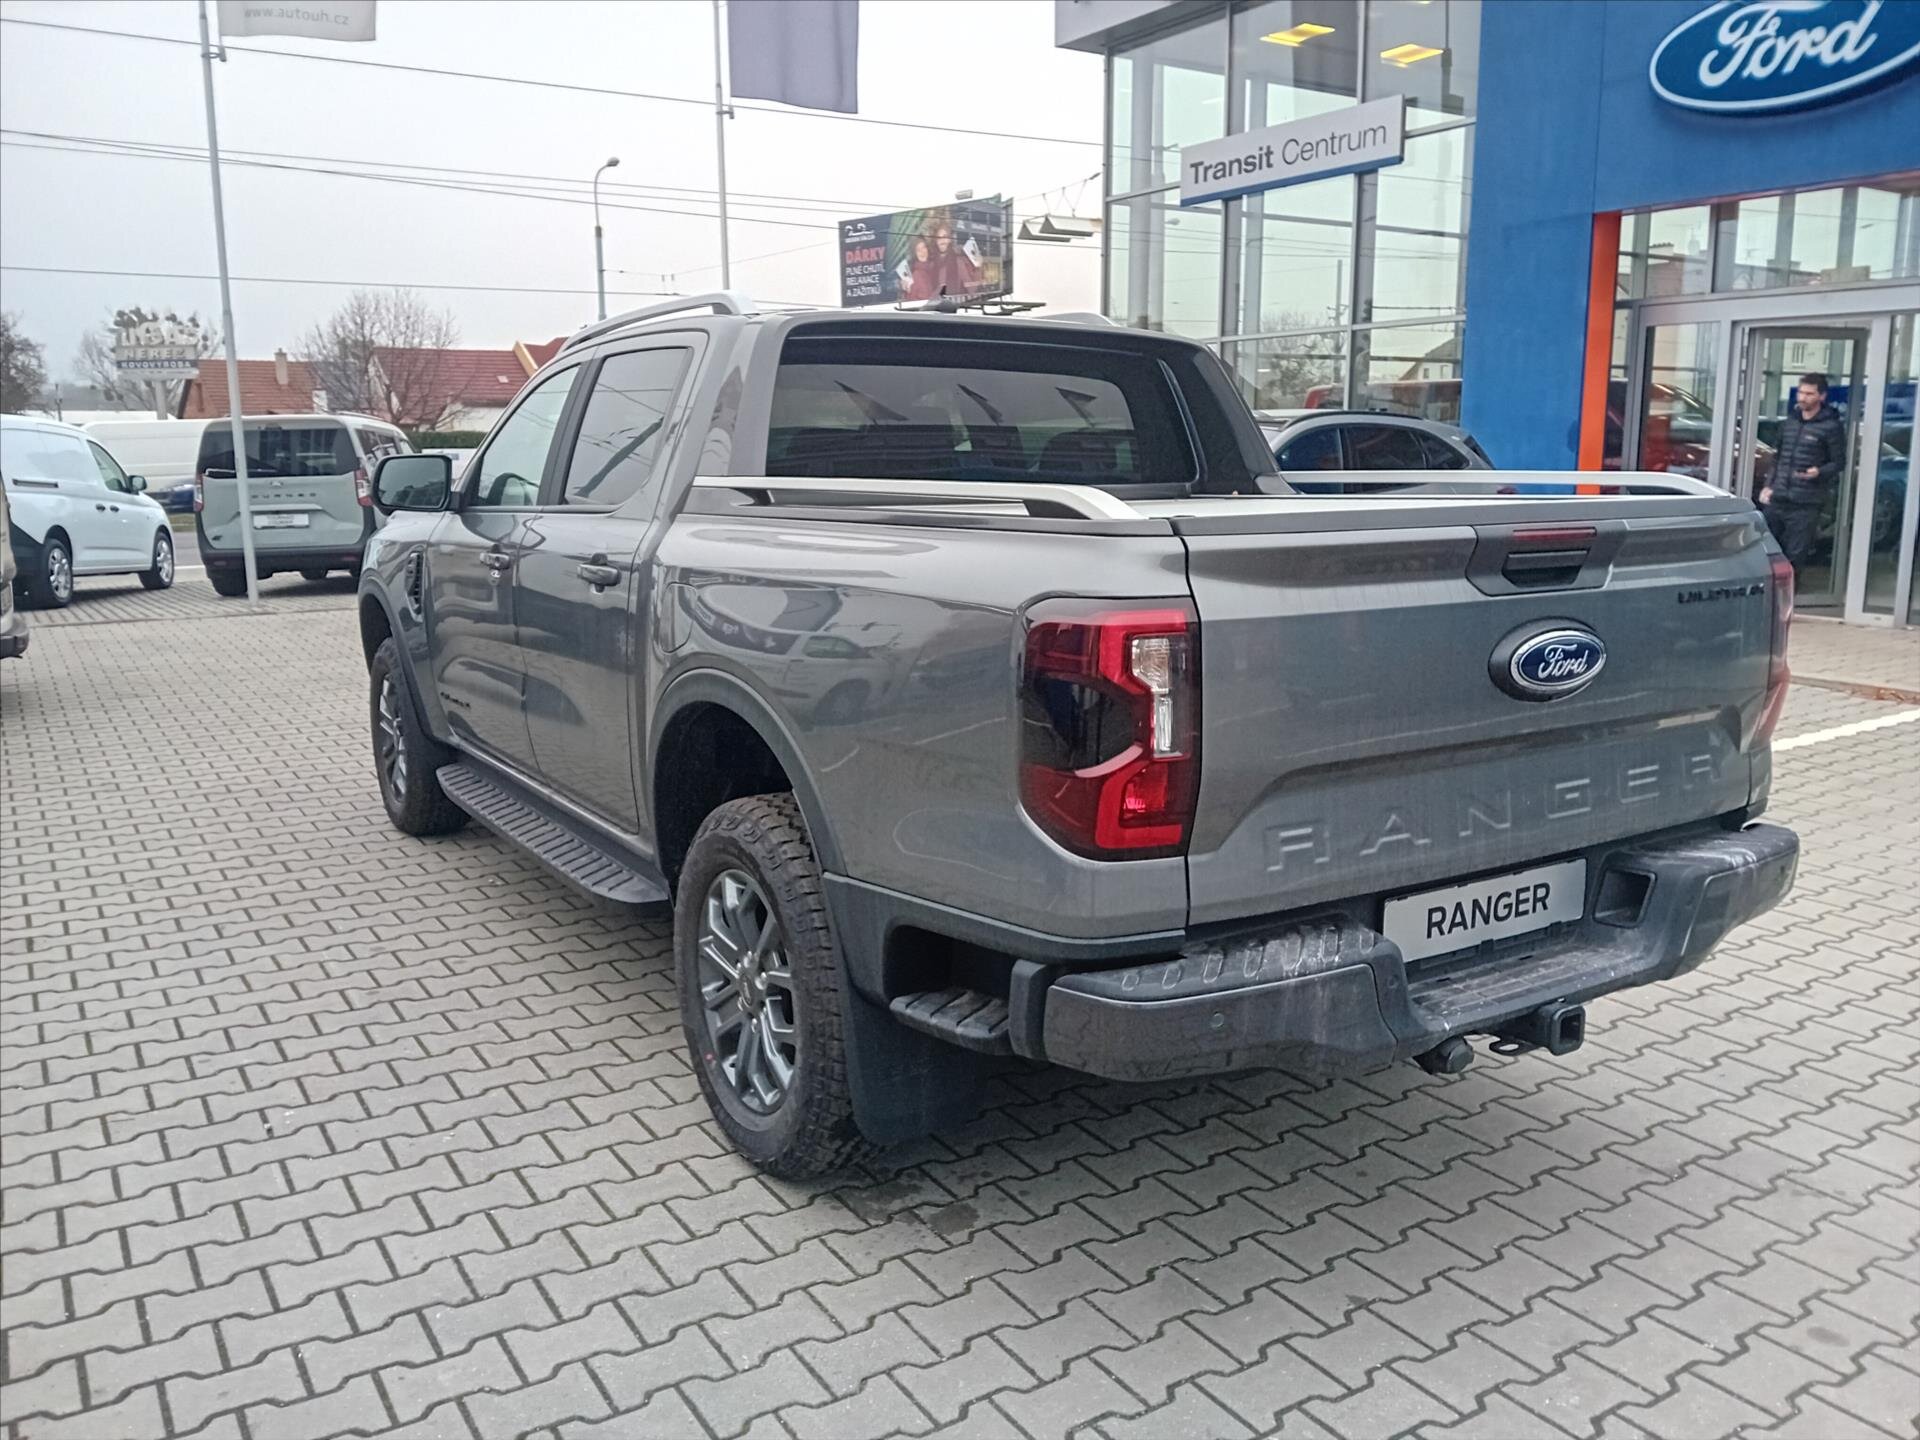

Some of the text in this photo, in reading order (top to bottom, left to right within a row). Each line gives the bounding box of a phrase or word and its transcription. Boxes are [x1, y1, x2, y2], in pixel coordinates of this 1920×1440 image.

[243, 7, 350, 26] www.autouh.cz
[1698, 0, 1885, 87] Ford
[1189, 124, 1387, 185] Transit Centrum
[845, 246, 885, 264] DÁRKY
[1537, 643, 1589, 679] Ford
[1264, 753, 1723, 873] RANGER
[1425, 881, 1552, 940] RANGER
